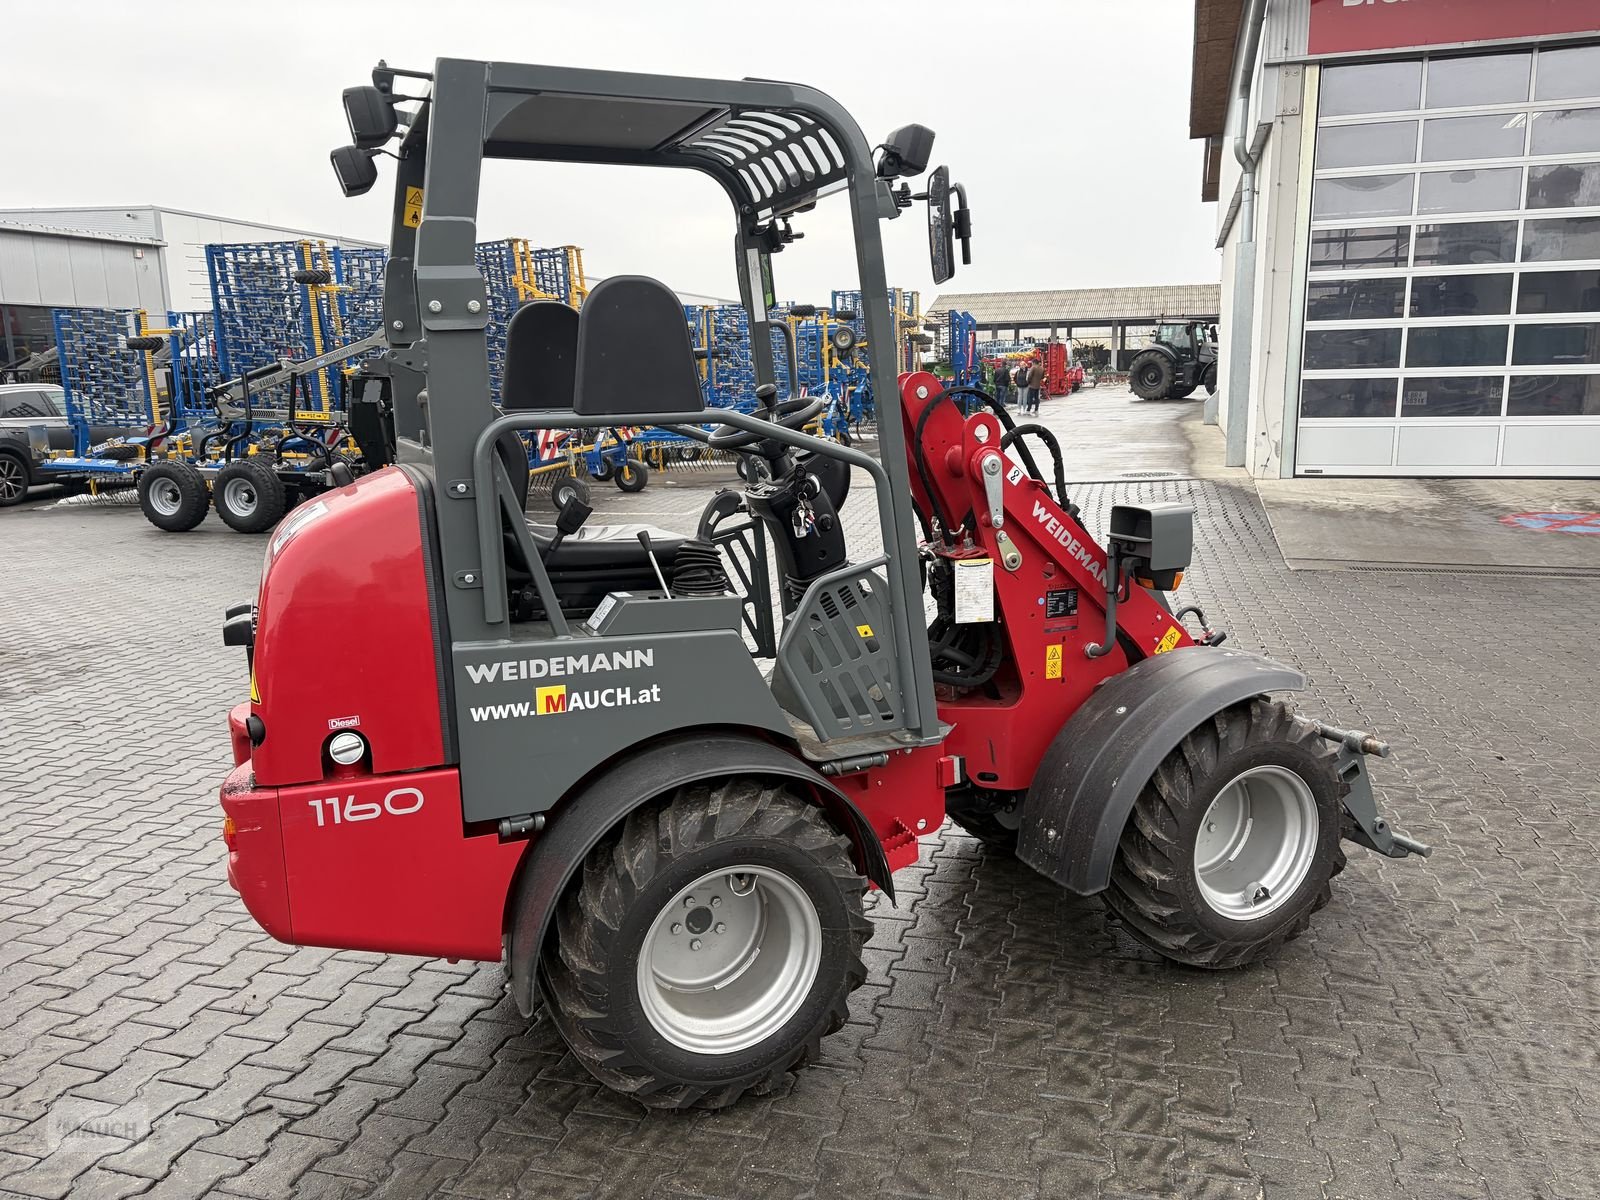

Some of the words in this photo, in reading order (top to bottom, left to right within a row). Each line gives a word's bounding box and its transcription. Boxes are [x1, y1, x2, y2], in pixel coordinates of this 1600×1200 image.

[1031, 500, 1123, 594] WEIDEMAN
[464, 648, 654, 684] WEIDEMANN
[470, 684, 661, 722] www.MAUCH.at
[330, 717, 358, 729] Diesel
[308, 787, 424, 827] 1160
